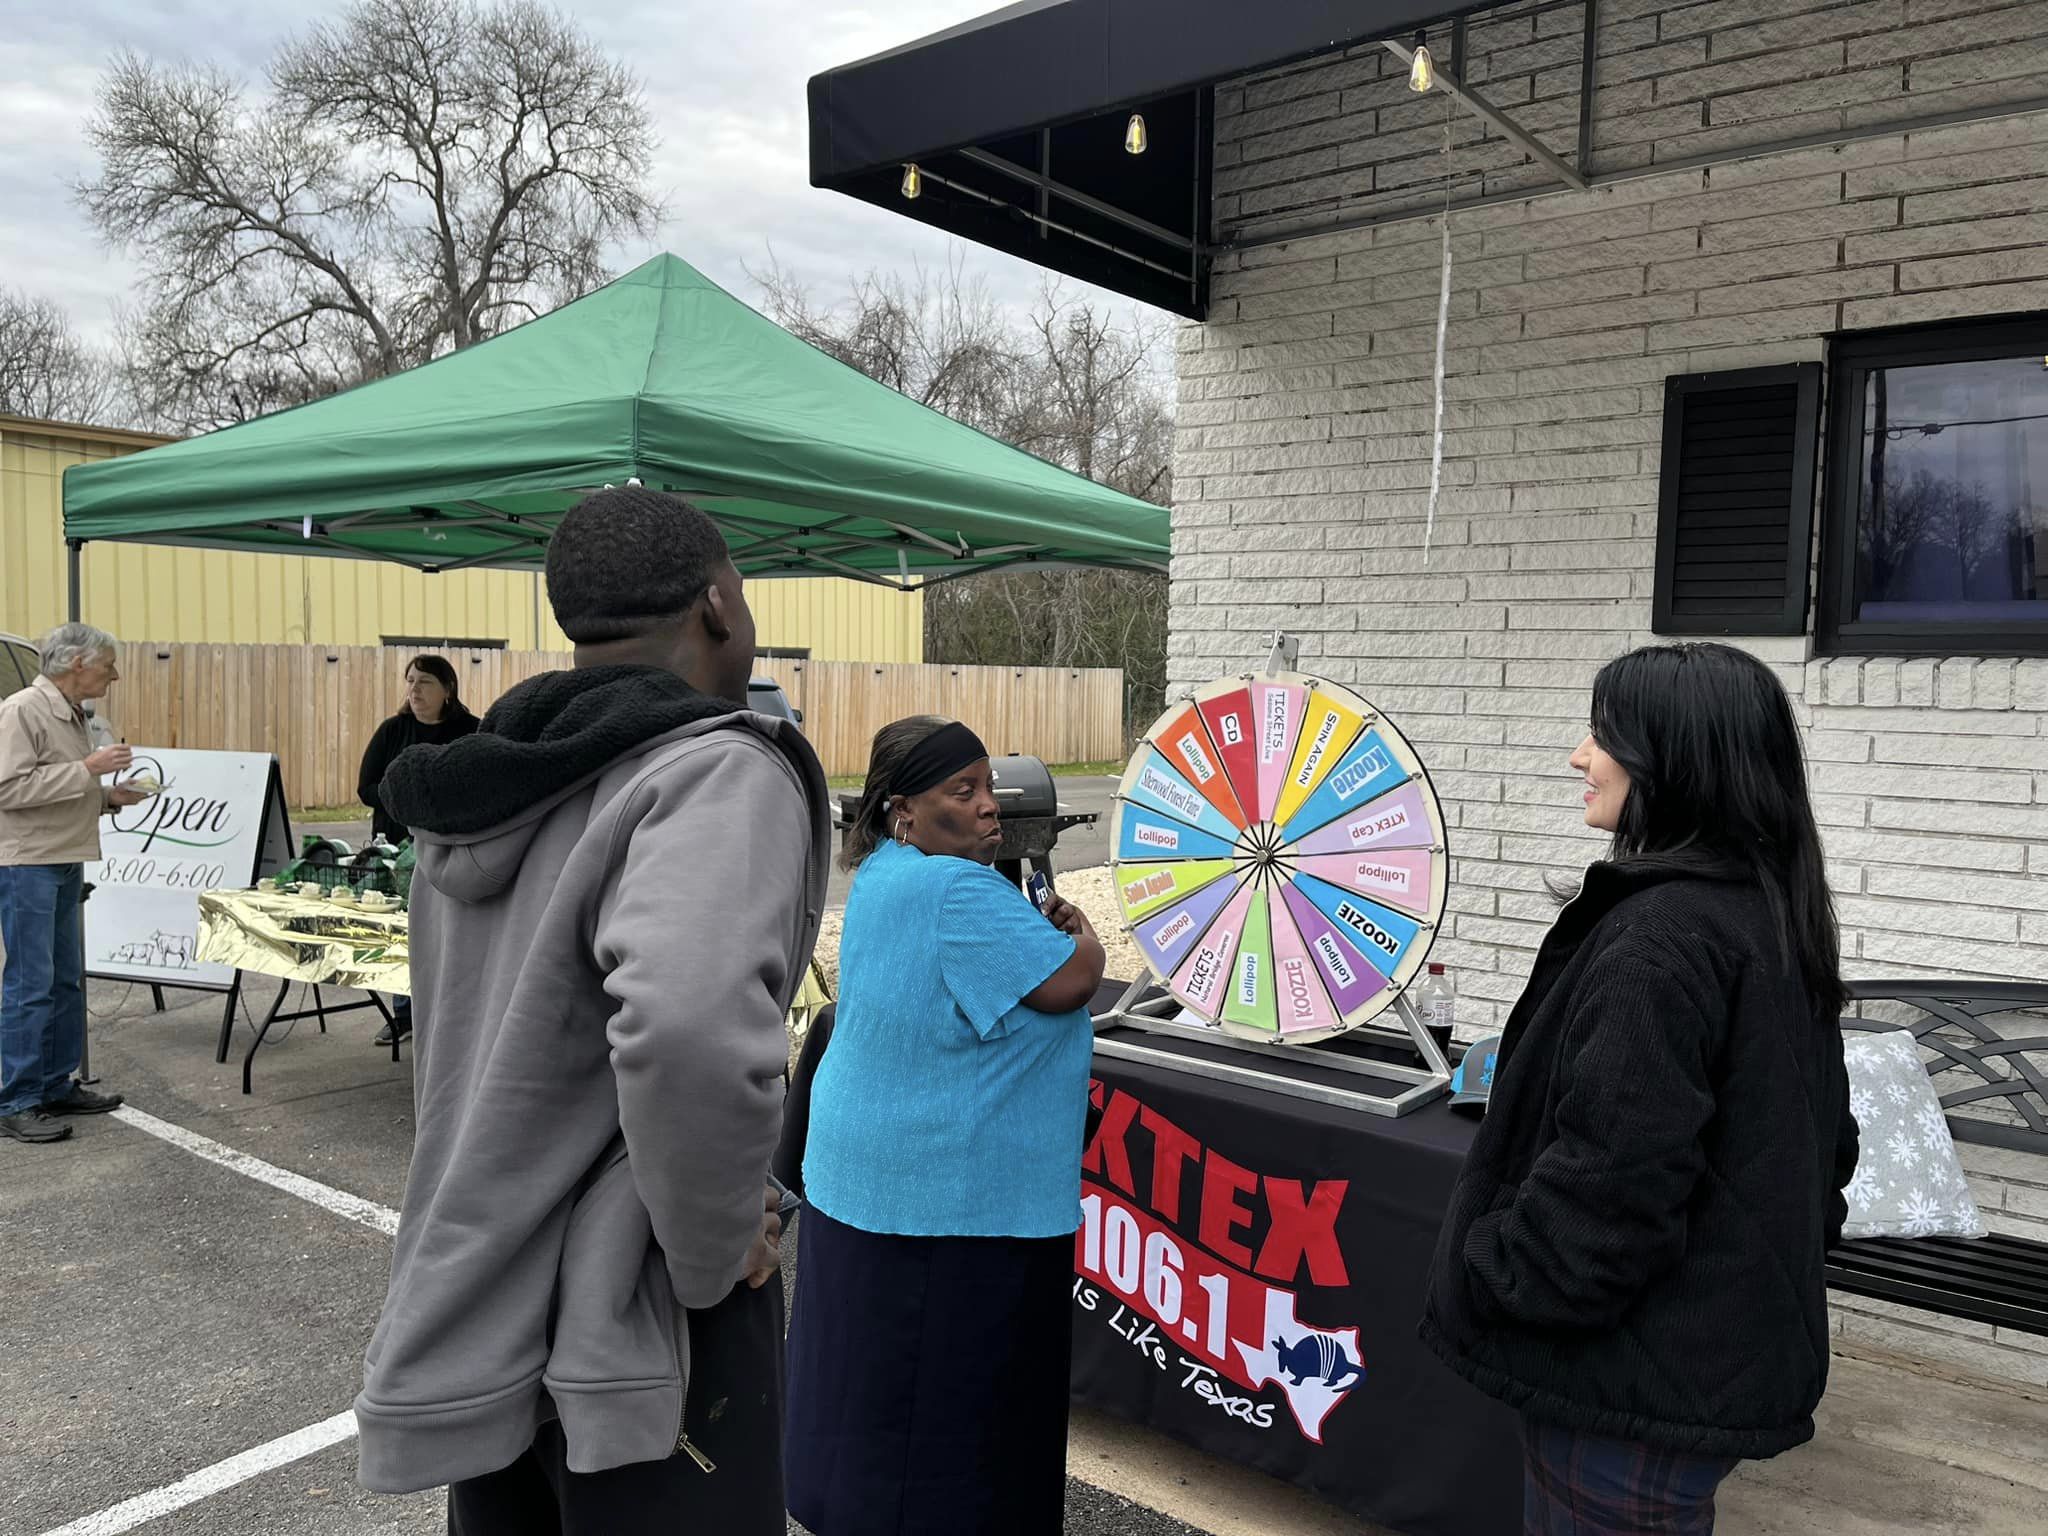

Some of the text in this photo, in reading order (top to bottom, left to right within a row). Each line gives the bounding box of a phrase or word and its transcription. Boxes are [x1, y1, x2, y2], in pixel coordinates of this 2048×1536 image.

[1225, 715, 1238, 742] CD
[1273, 691, 1286, 748] TICKETS
[1181, 738, 1210, 780] Lollipop
[1299, 712, 1337, 785] SPIN AGAIN
[111, 755, 232, 853] Open
[1352, 812, 1406, 839] KTEX Cap
[1138, 829, 1177, 846] Lollipop
[100, 857, 225, 889] 8:00-6:00
[1358, 864, 1406, 884] Lollipop
[1156, 914, 1190, 946] Lollipop
[1338, 904, 1399, 955] KOOZIE
[1185, 948, 1214, 996] TICKETS
[1244, 955, 1257, 1003] Lollipop
[1320, 937, 1351, 983] Lollipop
[1285, 960, 1313, 1018] KOOZIE
[1080, 1193, 1230, 1361] 106.1
